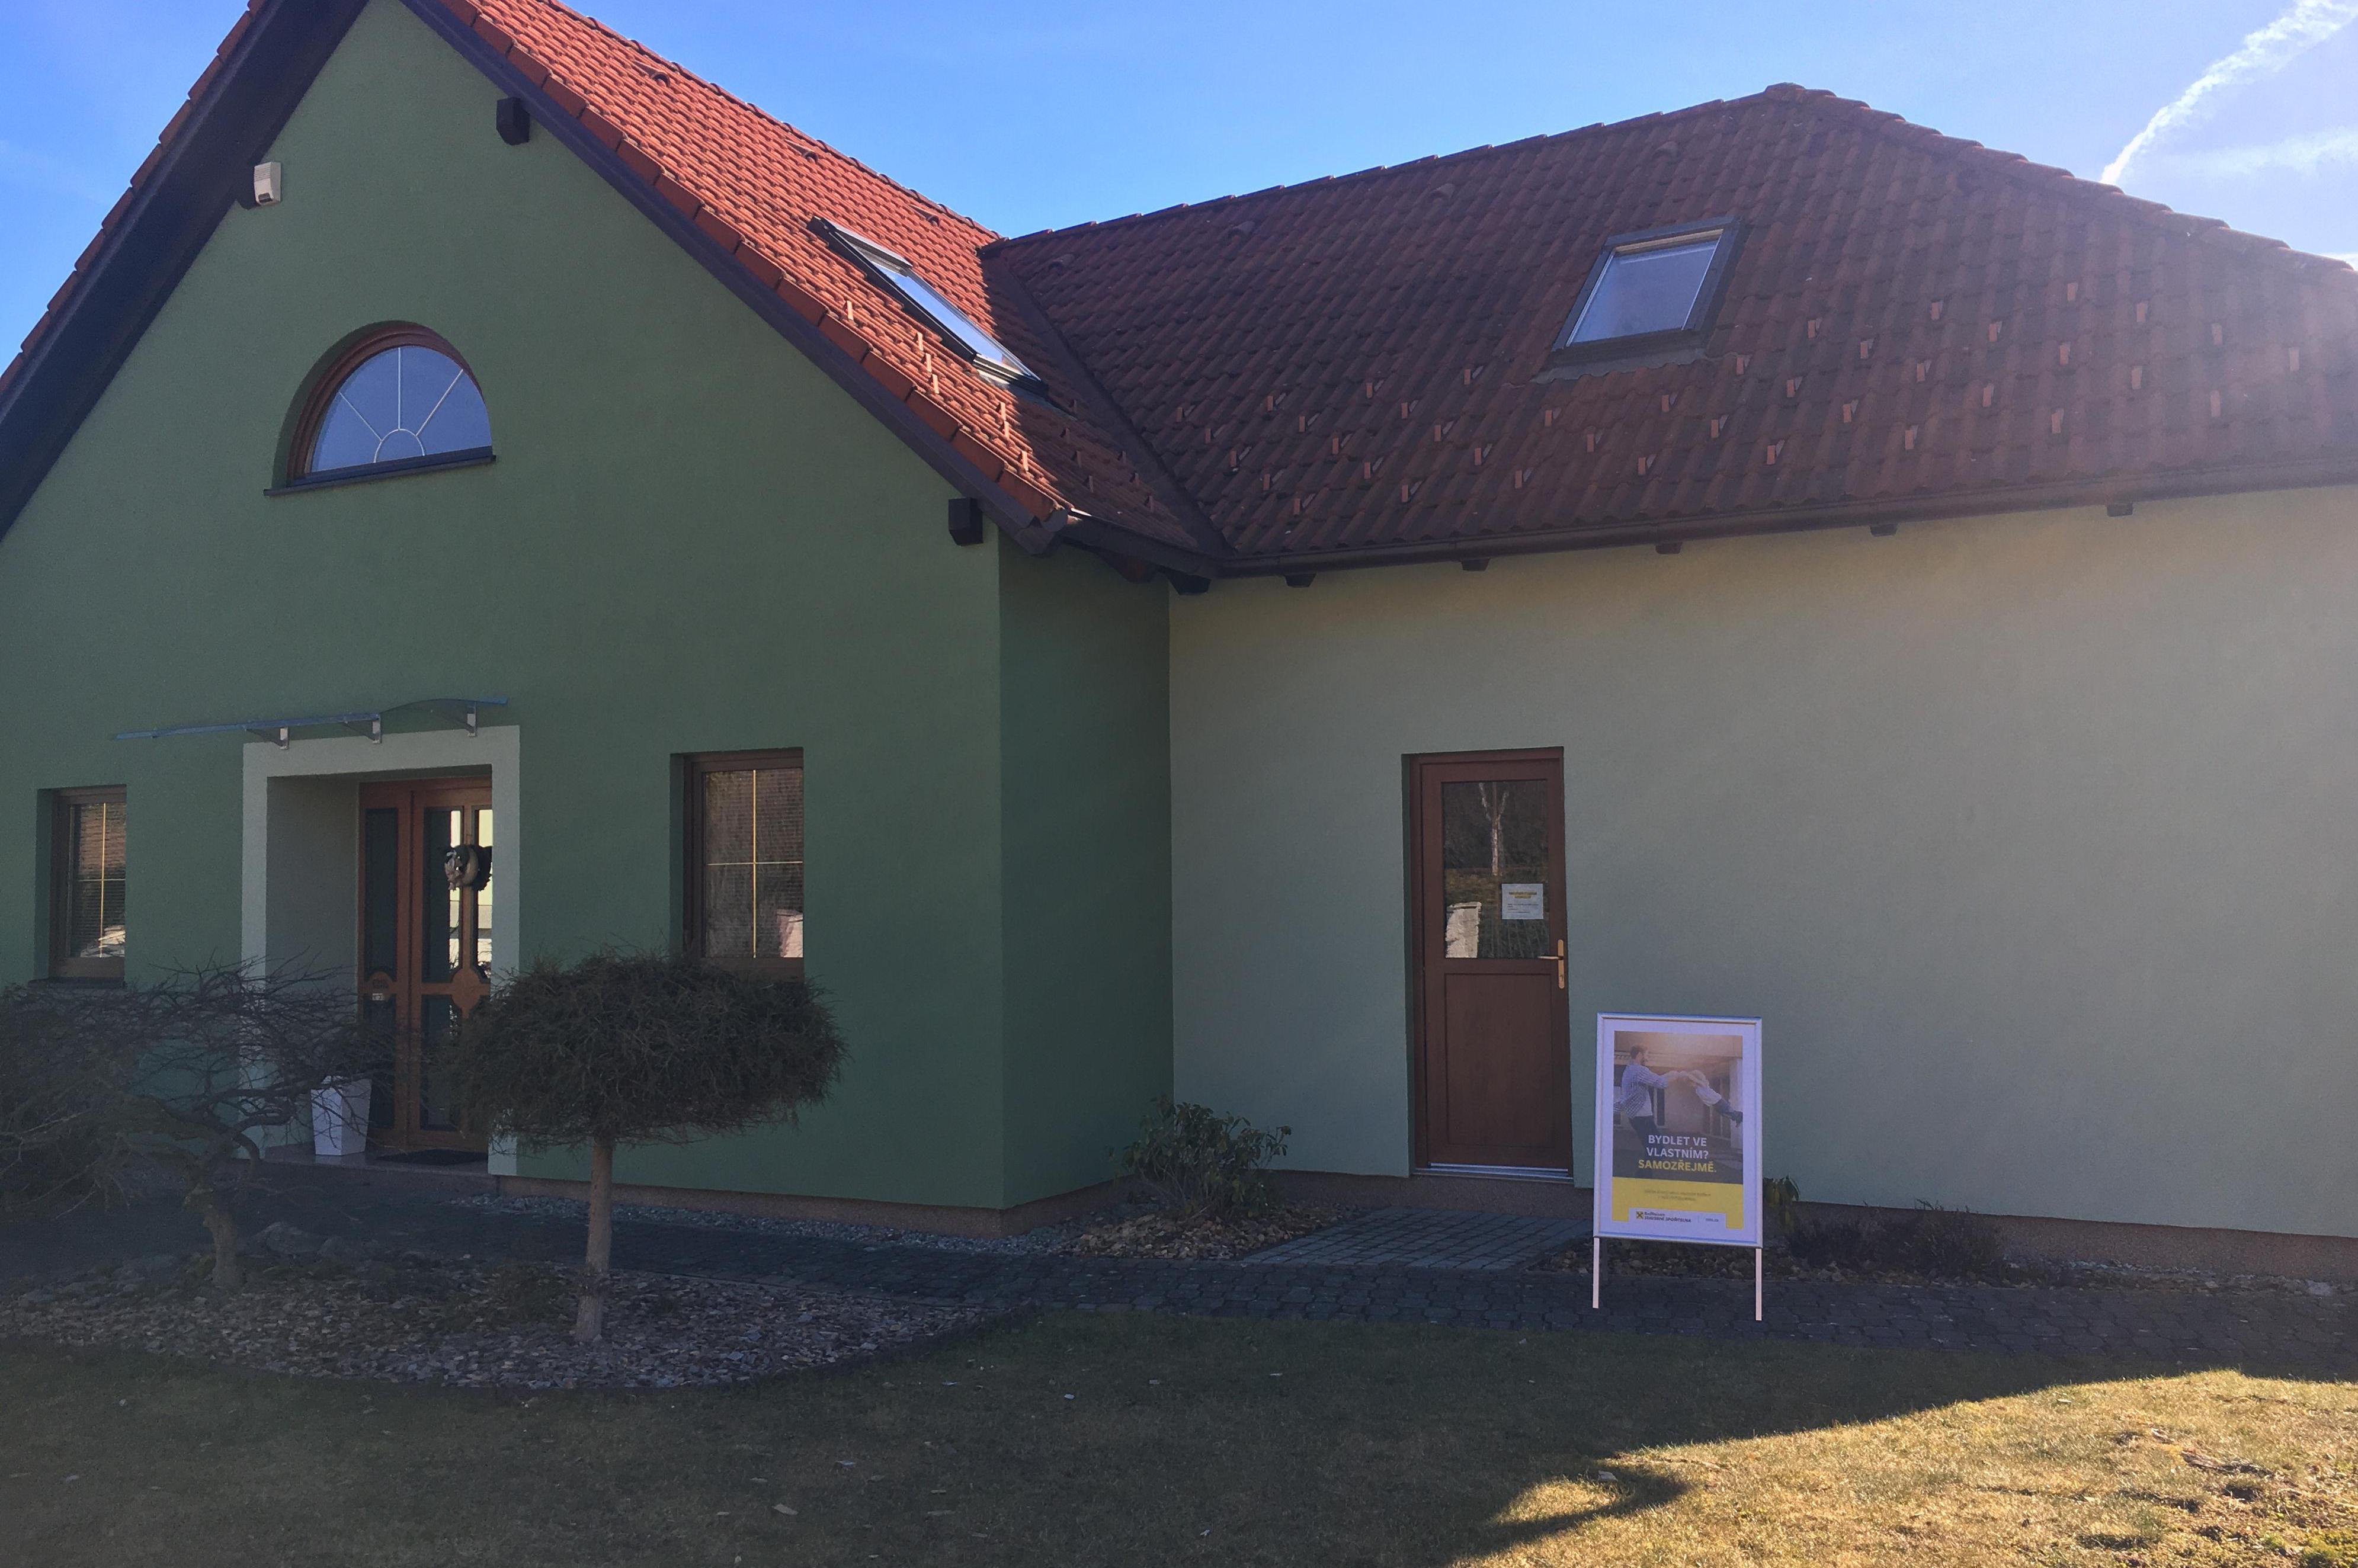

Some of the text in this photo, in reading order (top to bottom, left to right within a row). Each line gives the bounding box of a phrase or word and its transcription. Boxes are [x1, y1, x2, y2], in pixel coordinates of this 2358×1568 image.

[1648, 1134, 1707, 1146] BYDLET VE
[1646, 1147, 1709, 1159] VLASTNÍM?
[1638, 1159, 1717, 1173] SAMOZŘEJMĚ.
